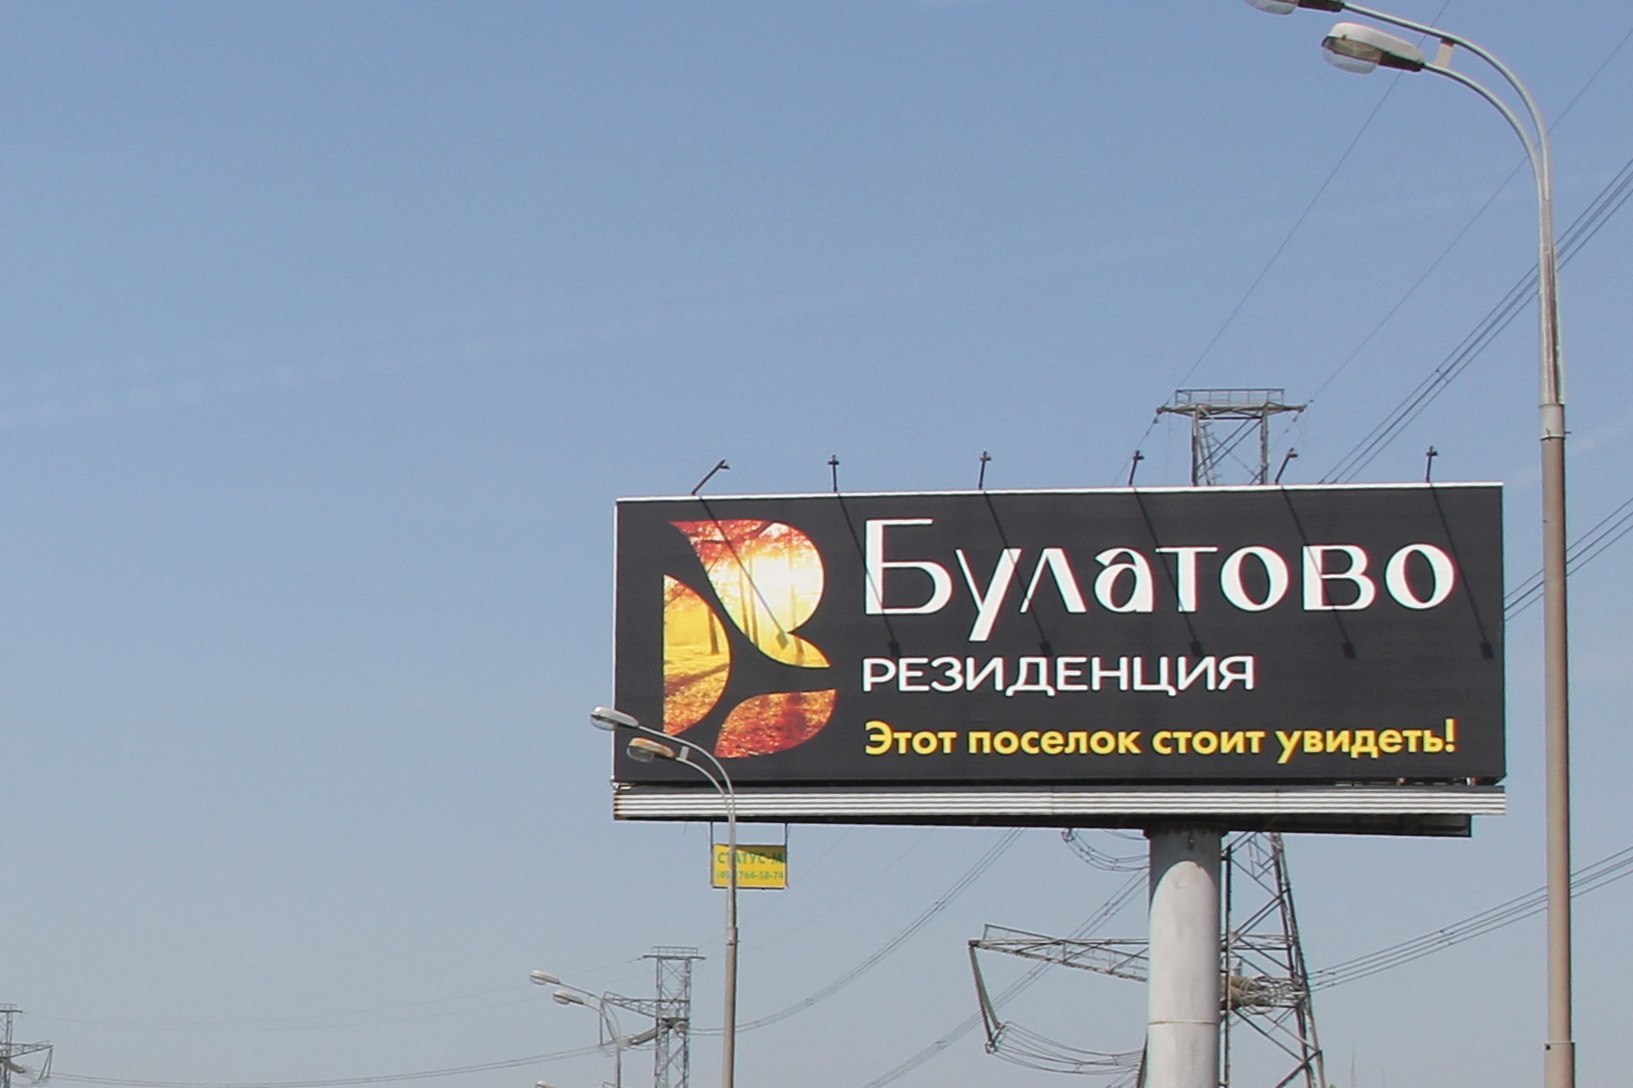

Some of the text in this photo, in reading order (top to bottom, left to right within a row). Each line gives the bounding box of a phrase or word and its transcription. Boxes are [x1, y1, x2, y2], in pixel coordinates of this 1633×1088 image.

[864, 518, 1455, 641] Булатово
[862, 656, 1256, 697] РЕЗИДЕНЦИЯ
[864, 718, 1457, 764] Этот поселок стоит увидеть!
